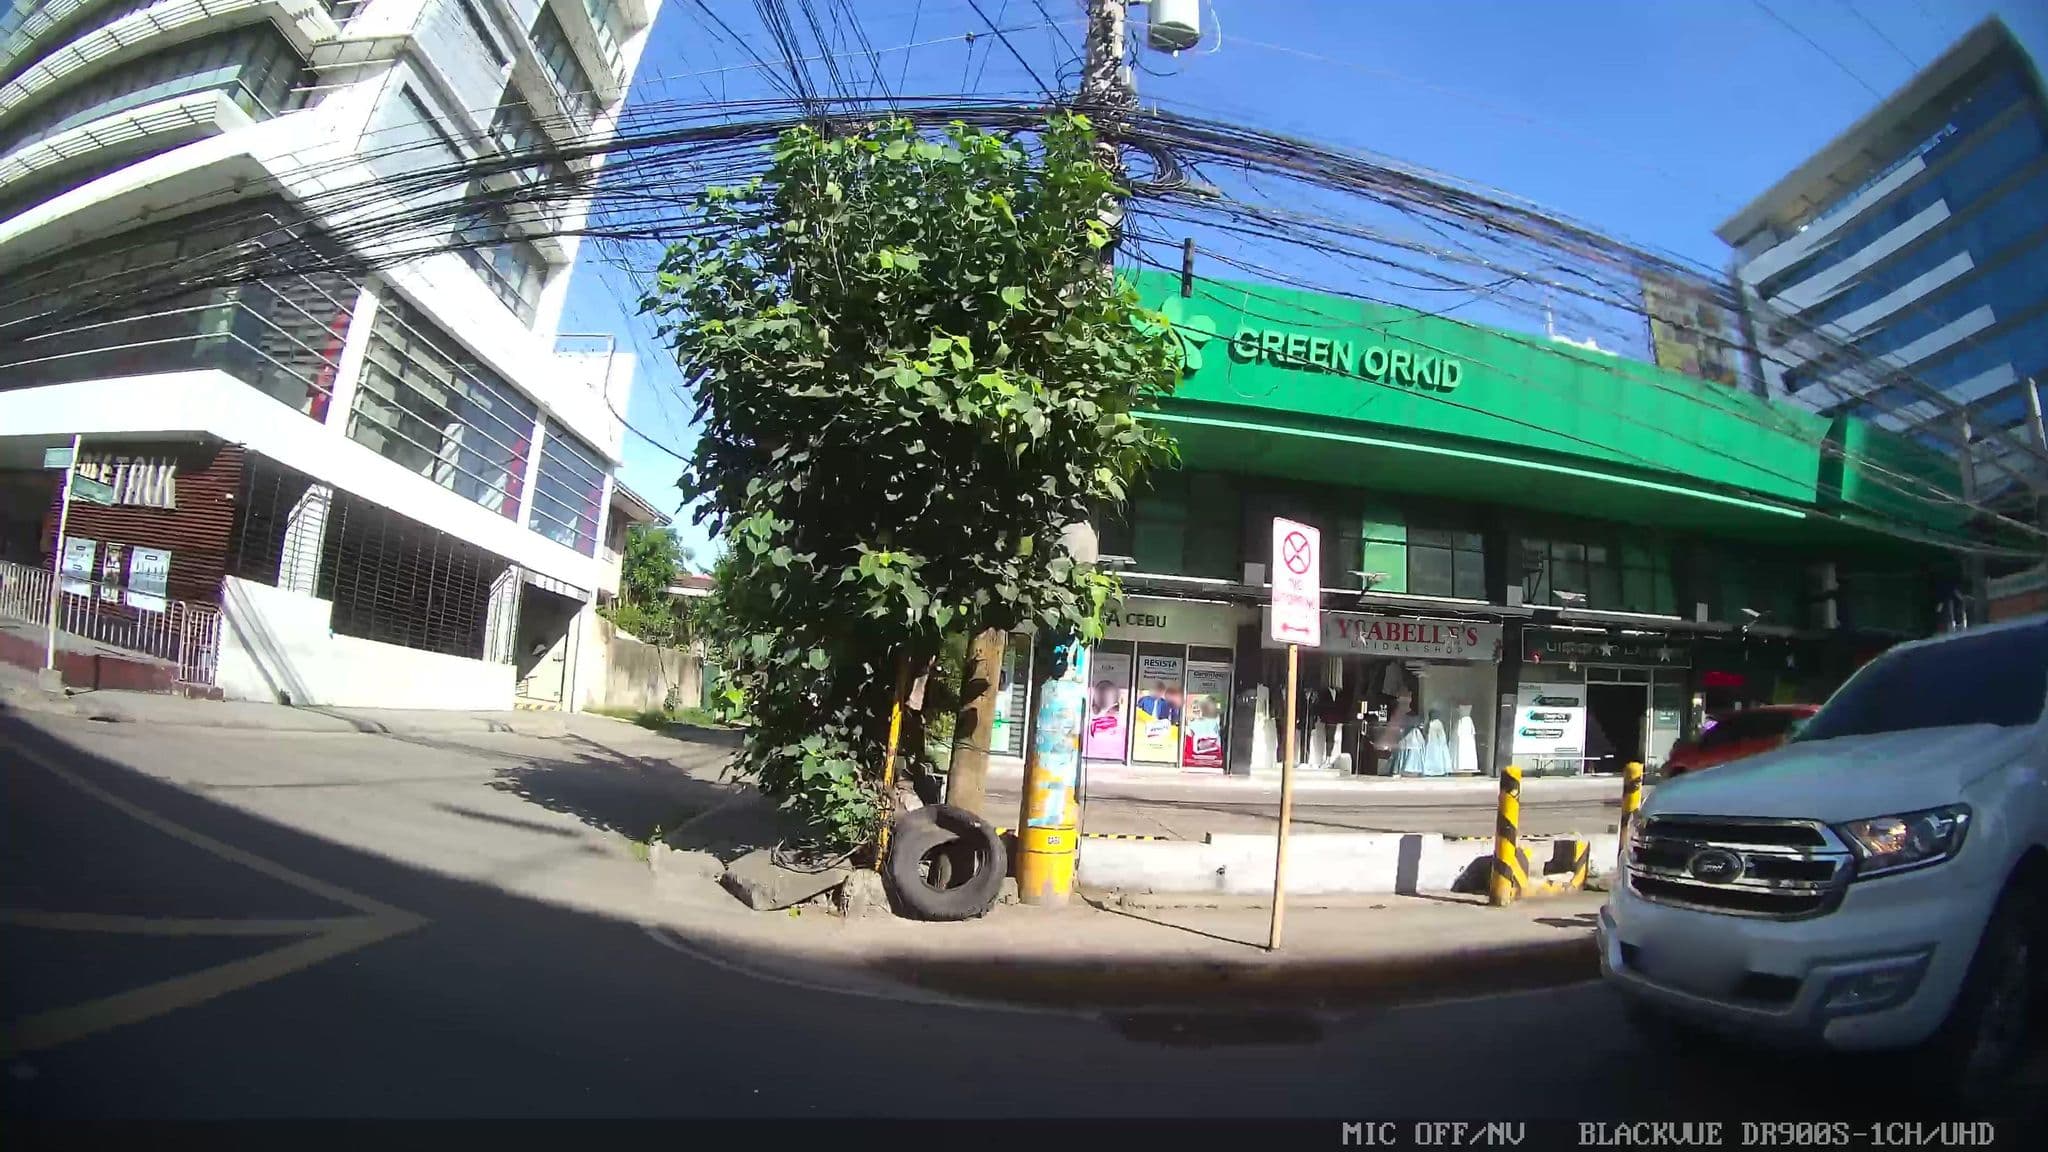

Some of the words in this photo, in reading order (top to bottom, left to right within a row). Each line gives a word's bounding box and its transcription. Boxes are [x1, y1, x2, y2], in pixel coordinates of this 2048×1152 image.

[1232, 327, 1354, 375] GREEN
[1363, 346, 1463, 389] ORKID
[1126, 613, 1166, 628] CEBU
[1423, 645, 1464, 655] SHOP
[1143, 658, 1178, 668] RESISTA
